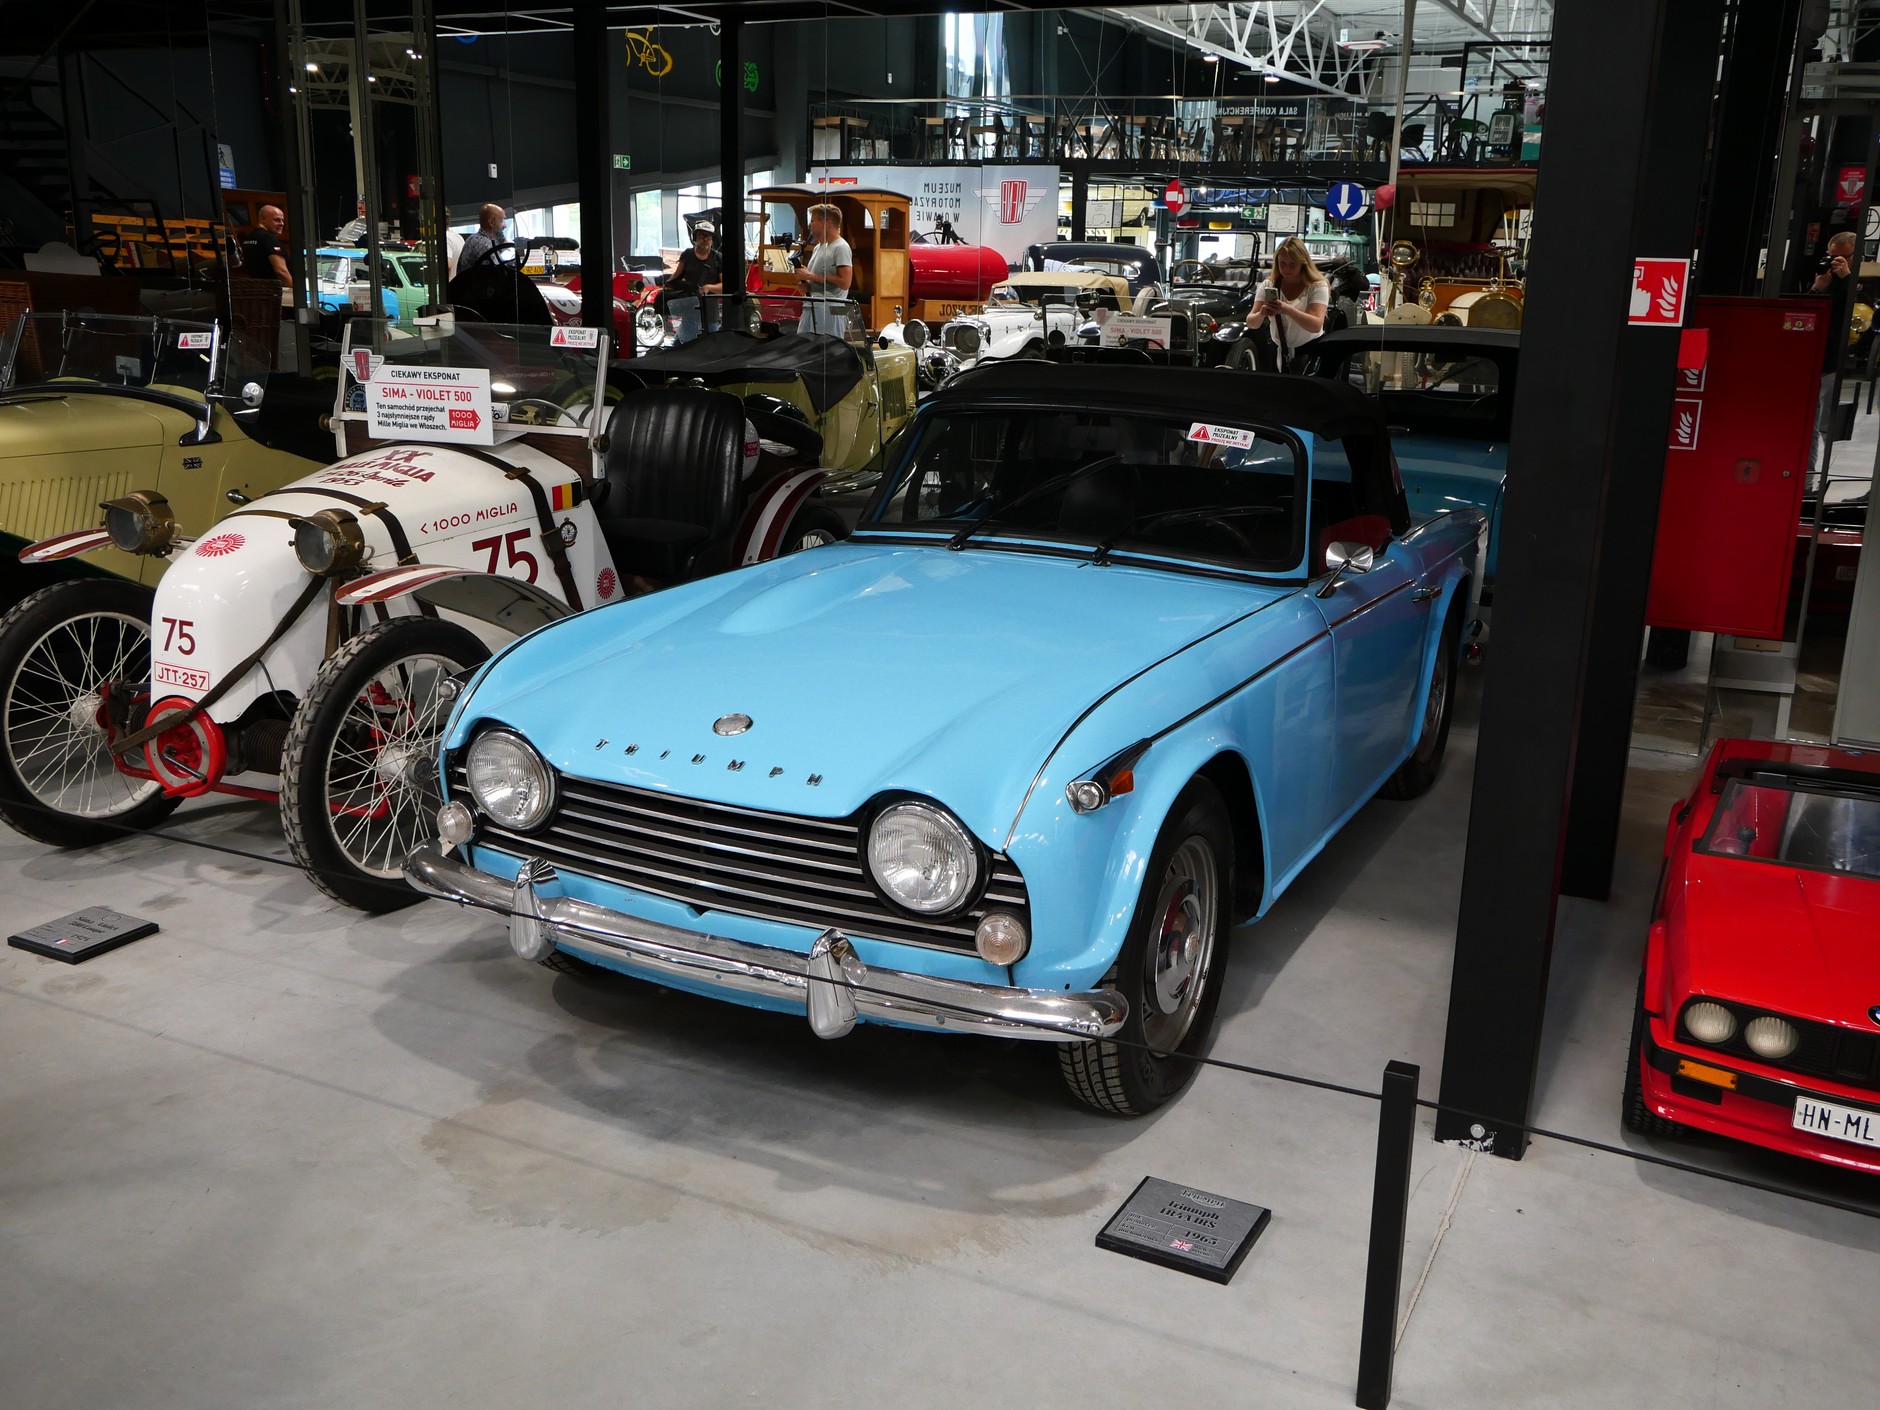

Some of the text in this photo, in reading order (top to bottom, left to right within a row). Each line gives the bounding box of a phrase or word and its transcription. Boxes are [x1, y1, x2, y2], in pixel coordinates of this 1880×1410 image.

[391, 370, 460, 381] CIEKAWY EKSPONAT
[382, 387, 407, 399] SIMA
[416, 388, 451, 401] VIOLET
[454, 391, 472, 402] 500
[376, 402, 386, 410] Ten
[387, 403, 415, 412] samochód
[378, 420, 391, 428] Mille
[392, 421, 408, 430] Miglia
[420, 414, 435, 422] rajdy
[451, 420, 475, 428] MIGLIA
[433, 502, 518, 531] 1000 MIGLIA
[471, 527, 539, 584] 75
[162, 616, 196, 656] 75
[595, 738, 824, 786] TRIUMPH
[1184, 1230, 1218, 1246] 1965
